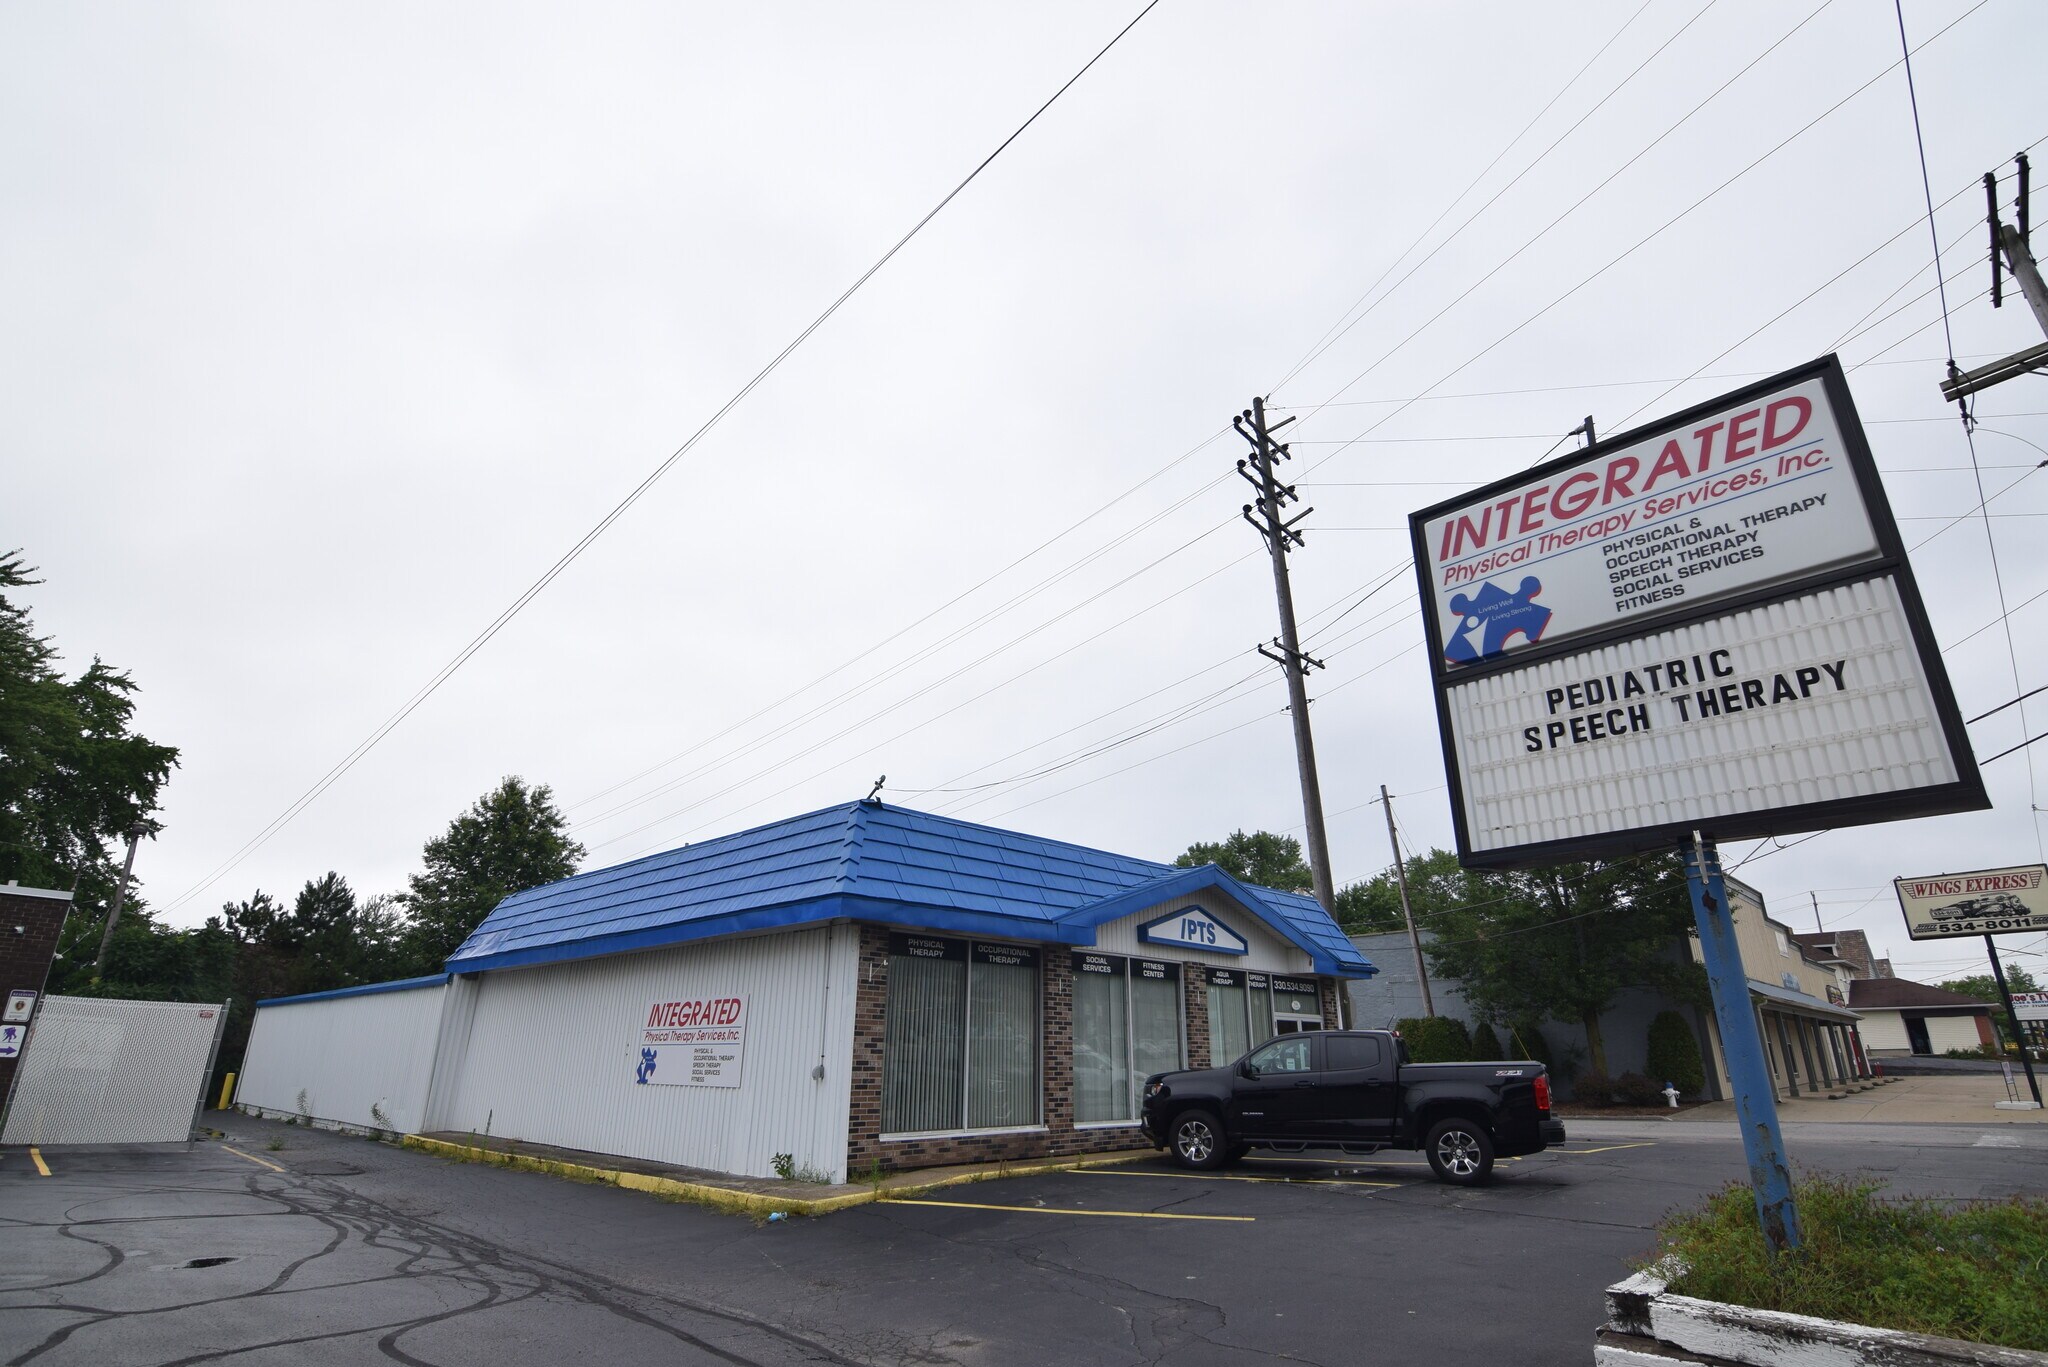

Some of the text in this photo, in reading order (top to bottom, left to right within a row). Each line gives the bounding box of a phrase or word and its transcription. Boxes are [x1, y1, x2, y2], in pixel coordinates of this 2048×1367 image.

[1439, 396, 1812, 561] INTEGRATED
[1444, 449, 1830, 585] Physical Therapy Services, Inc.
[1602, 517, 1702, 556] PHYSICAL &
[1606, 493, 1827, 570] OCCUPATIONAL THERAPY
[1609, 530, 1759, 584] SPEECH THERAPY
[1612, 545, 1764, 598] SOCIAL SERVICES
[1616, 584, 1685, 613] FITNESS
[1478, 604, 1499, 614] Living
[1492, 606, 1532, 621] Living Strong
[1546, 648, 1734, 714] PEDIATRIC
[1524, 660, 1848, 752] SPEECH THERAPY
[1915, 874, 2028, 897] WINGS EXPRESS
[1181, 918, 1216, 944] IPTS
[1939, 917, 2031, 932] 534-8011
[908, 938, 945, 949] PHYSICAL
[978, 945, 1031, 957] OCCUPATIONAL
[909, 948, 944, 958] THERAPY
[989, 955, 1021, 965] THERAPY
[1085, 956, 1108, 965] SOCIAL
[1082, 964, 1111, 973] SERVICES
[1142, 962, 1165, 971] FITNESS
[1143, 970, 1164, 978] CENTER
[1212, 977, 1234, 985] THERAPY
[647, 998, 741, 1027] INTEGRATED
[645, 1031, 670, 1043] Physical
[670, 1031, 696, 1043] Therapy
